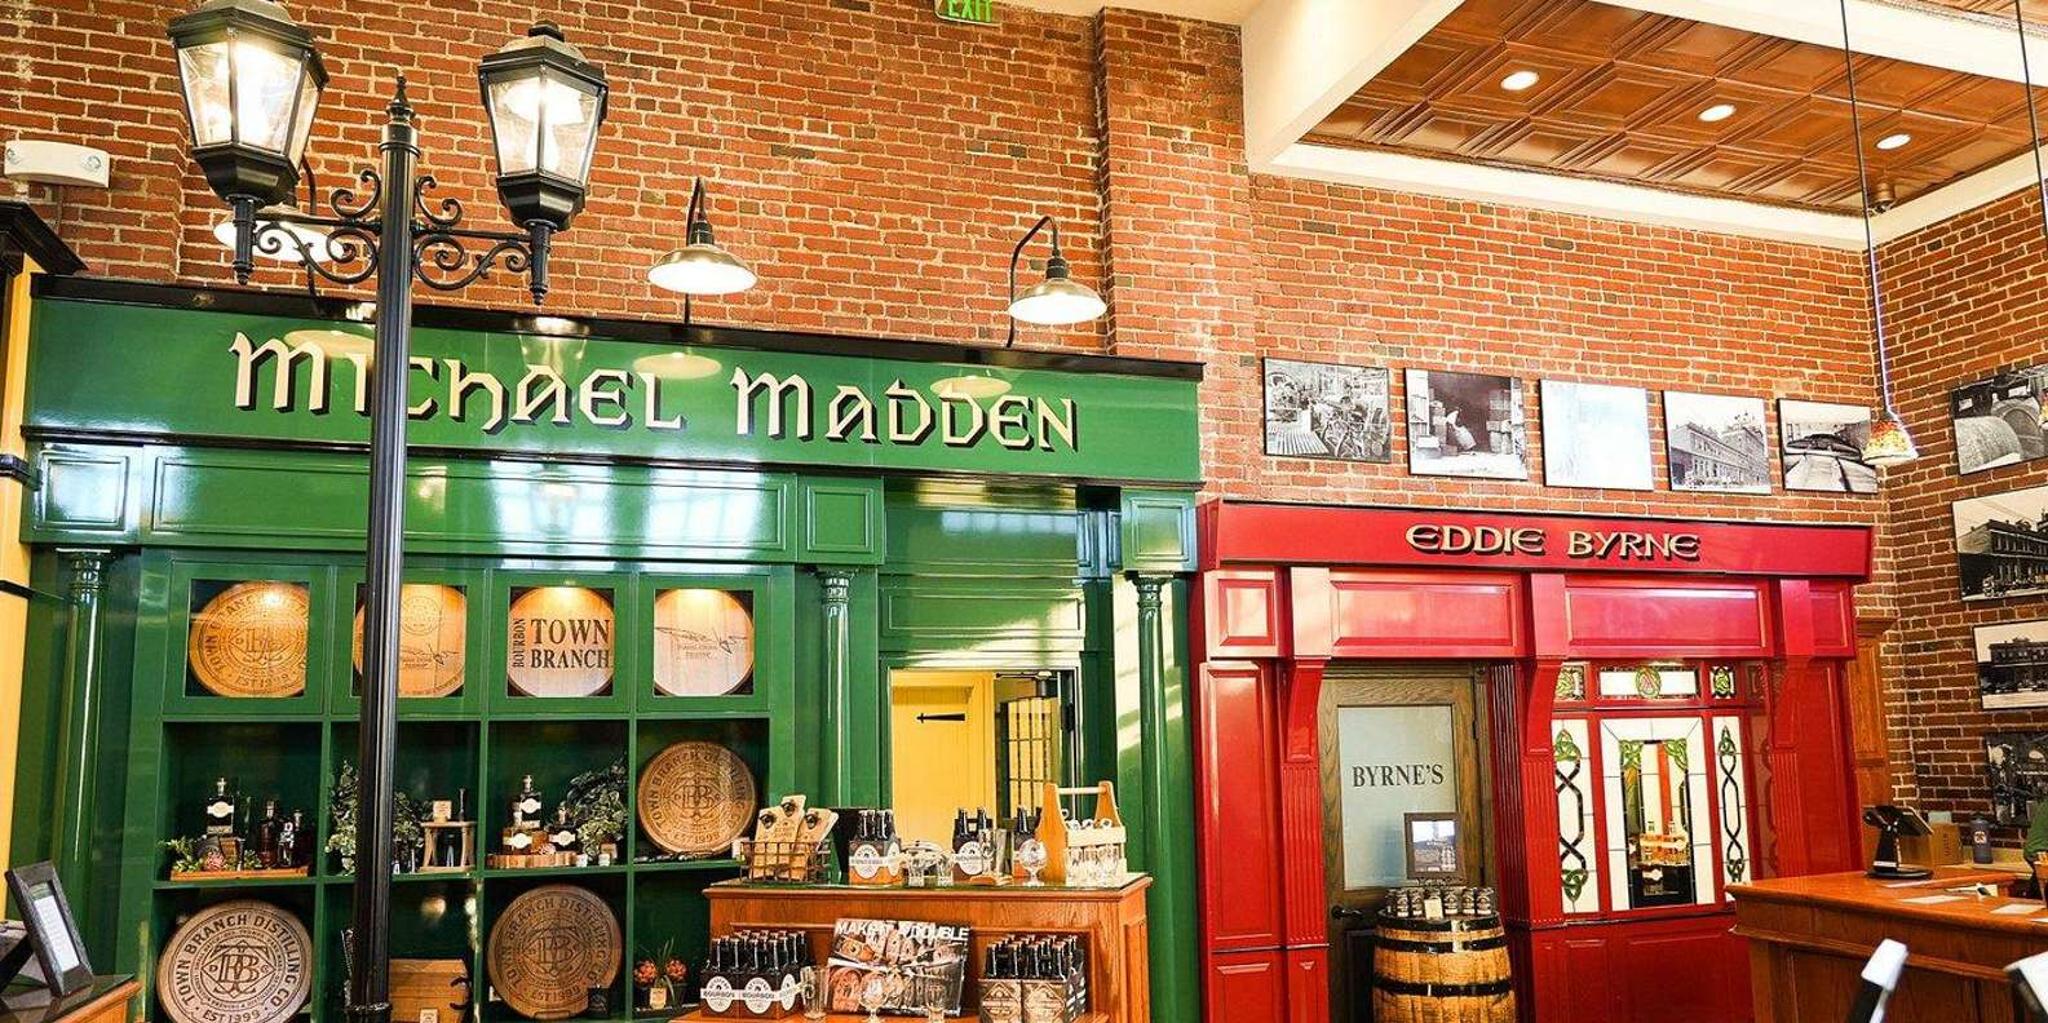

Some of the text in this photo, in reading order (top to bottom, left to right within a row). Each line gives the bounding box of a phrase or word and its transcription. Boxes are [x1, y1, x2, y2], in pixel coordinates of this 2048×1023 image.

[730, 366, 1079, 452] MADDEN
[1405, 524, 1701, 561] EDDIE BYRNE
[512, 618, 526, 668] BOURBON
[530, 619, 611, 645] TOWN
[530, 649, 610, 669] BRANCH
[1351, 763, 1445, 787] BYRNE'S
[184, 914, 248, 954] BRANCH
[253, 915, 300, 985] DISTILLING
[176, 959, 194, 1006] TOWN
